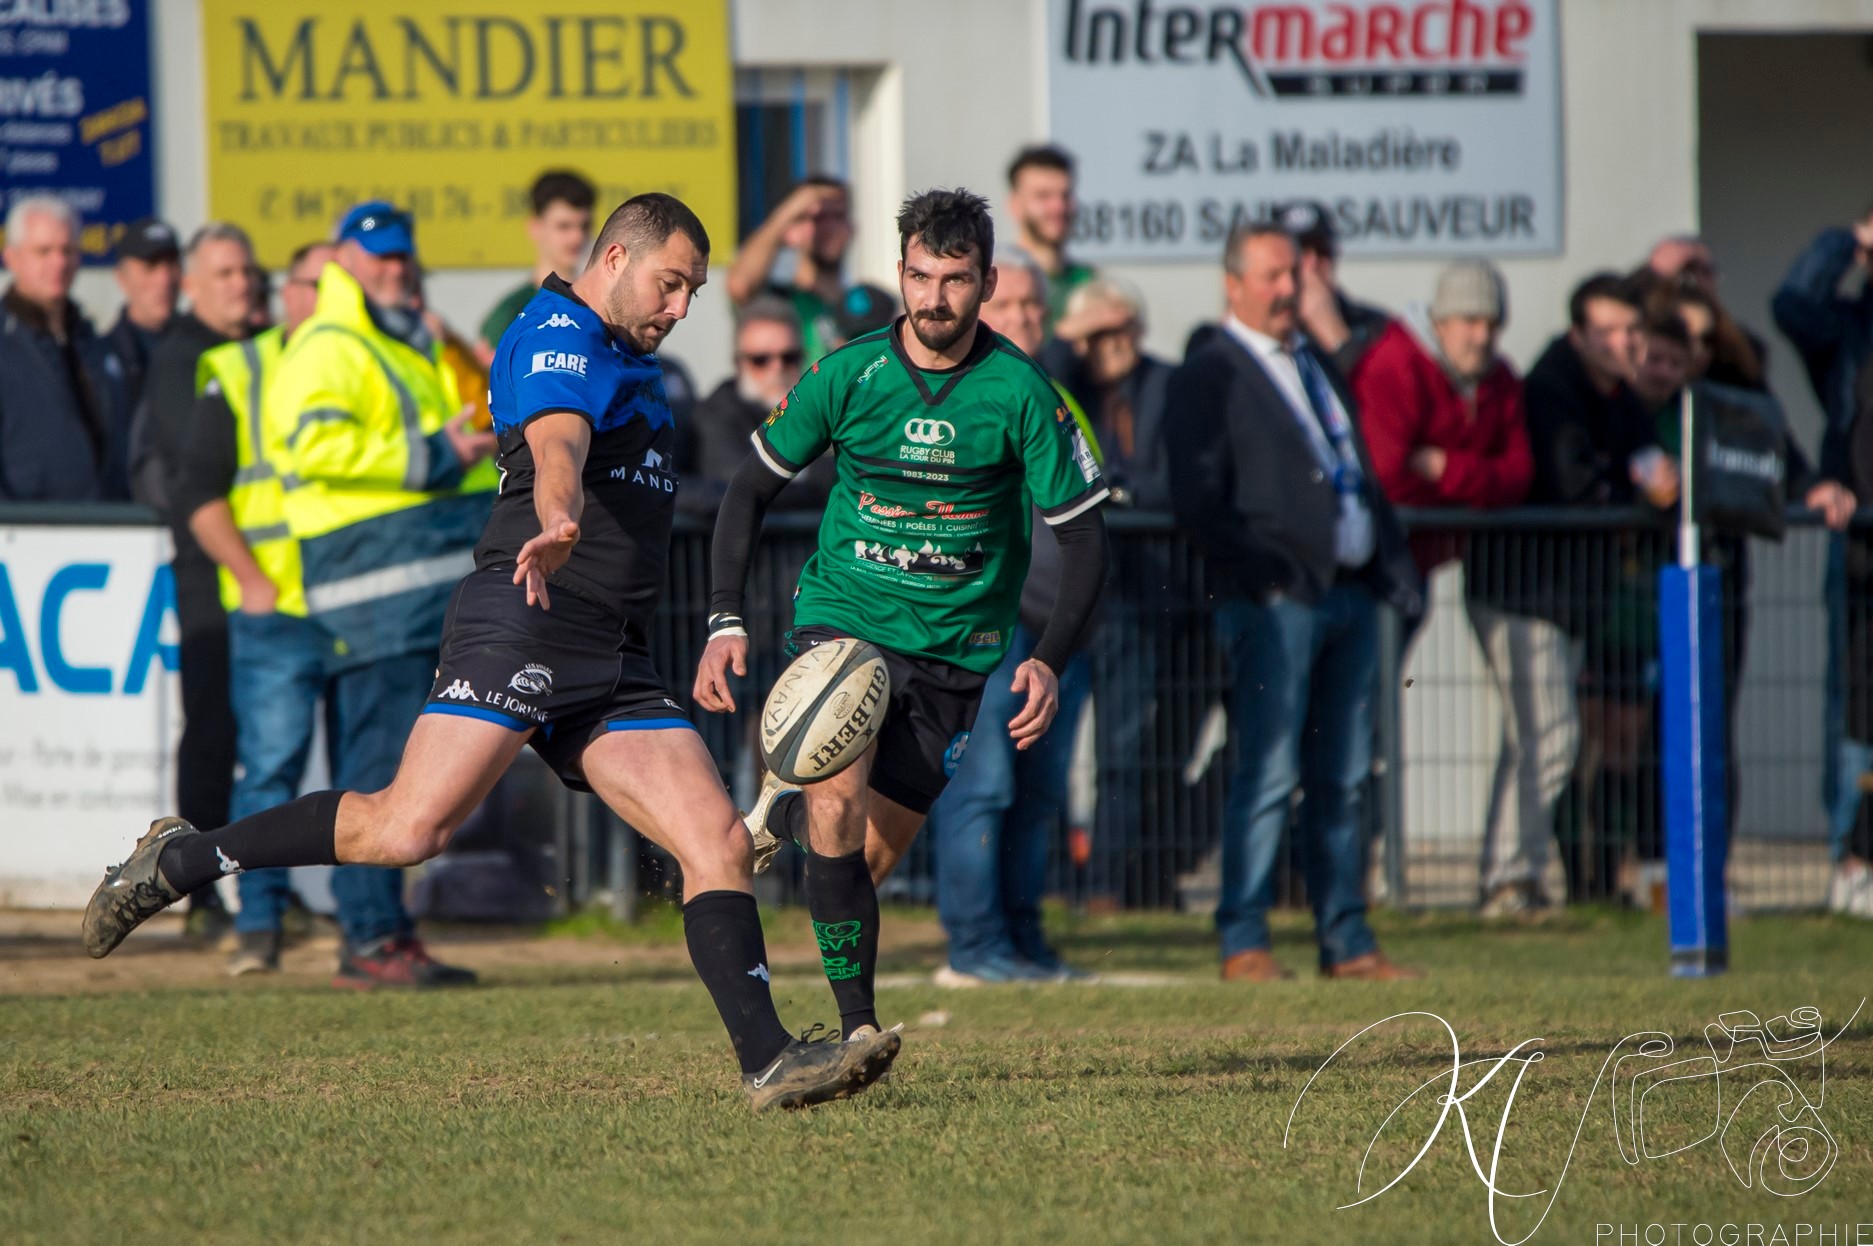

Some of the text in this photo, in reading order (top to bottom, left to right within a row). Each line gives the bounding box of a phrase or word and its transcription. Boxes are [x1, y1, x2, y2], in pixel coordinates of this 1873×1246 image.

[235, 16, 698, 99] MANDIER
[1142, 127, 1462, 173] ZA La Maladière
[1336, 197, 1536, 239] SAUVEUR
[900, 444, 955, 459] RUGBY CLUB
[910, 454, 929, 462] TOUR
[942, 457, 955, 465] PIN
[610, 465, 680, 493] MAND
[902, 470, 949, 482] 1983-2023
[858, 511, 896, 528] HEMINÉES
[906, 521, 936, 531] POÊLES
[485, 690, 504, 706] LE
[808, 664, 888, 773] GILBERT
